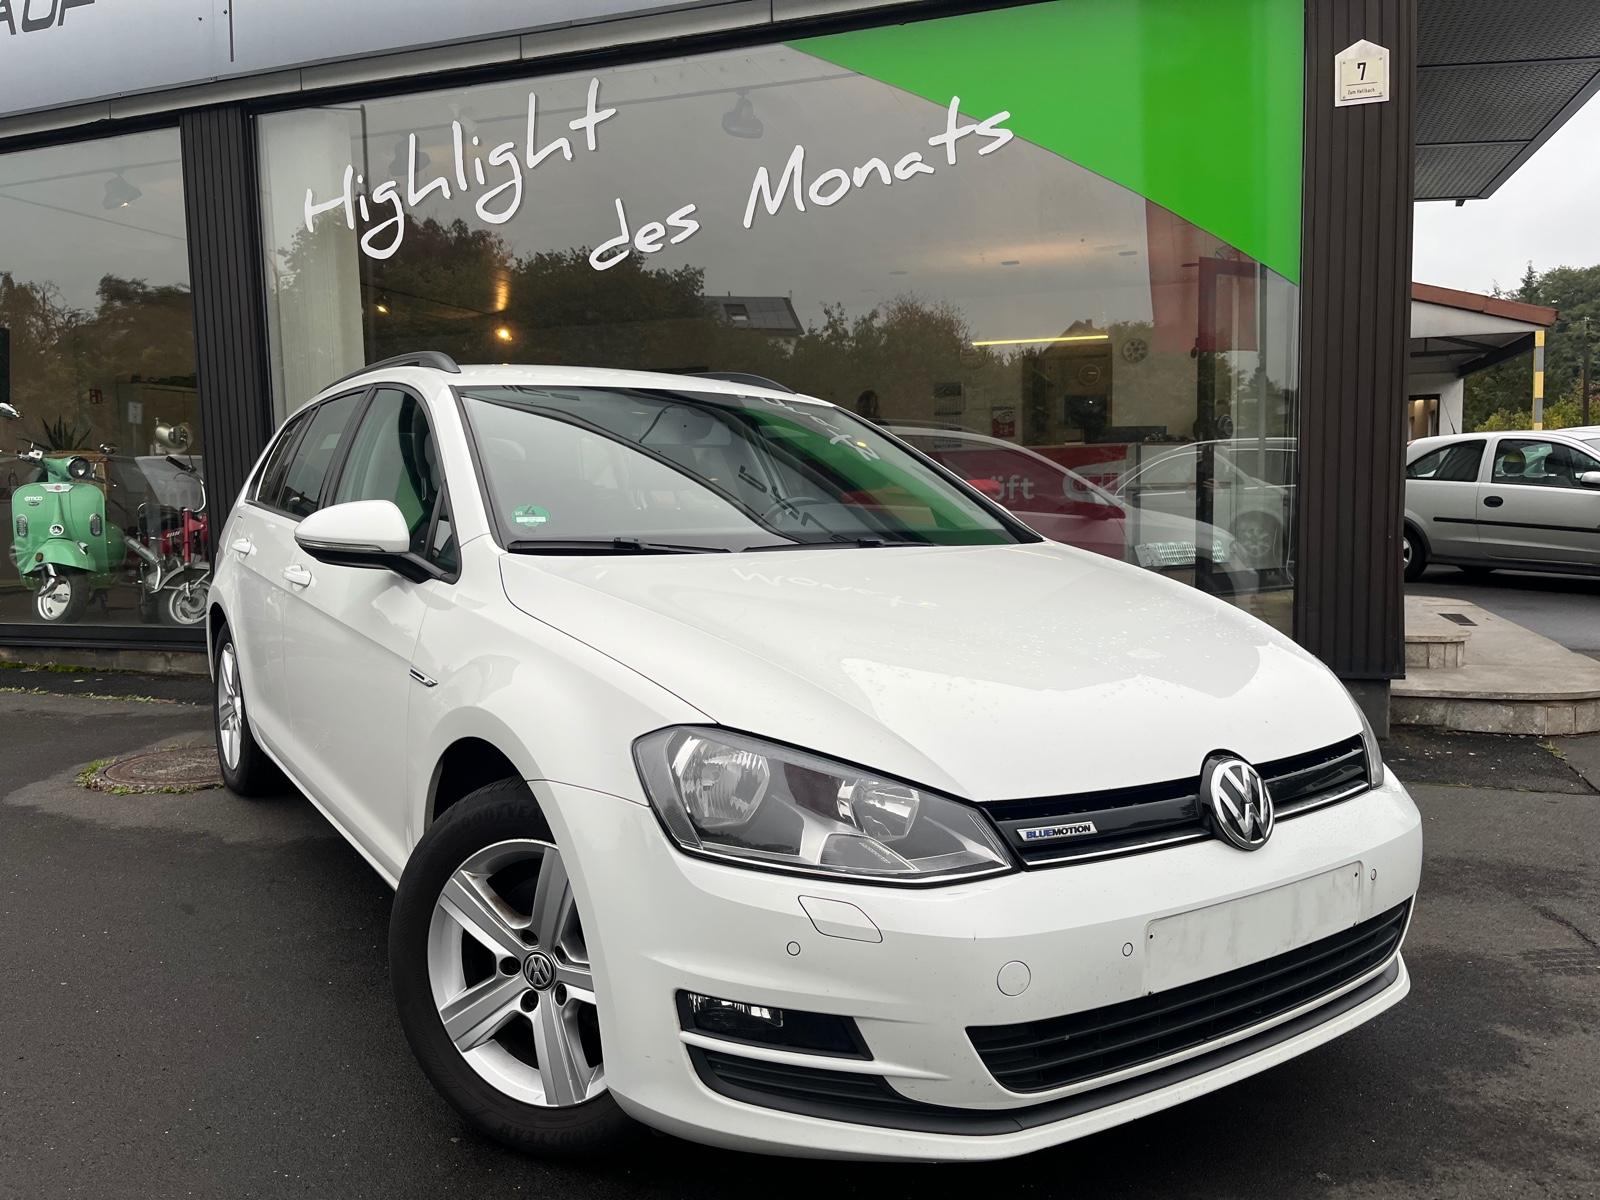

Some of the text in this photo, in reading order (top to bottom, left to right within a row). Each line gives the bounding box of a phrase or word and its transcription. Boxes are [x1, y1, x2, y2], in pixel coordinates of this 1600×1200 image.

[1357, 62, 1367, 81] 7
[305, 78, 617, 261] Highlight
[588, 96, 1013, 270] des Monats
[1026, 825, 1091, 839] BLUEMOTION
